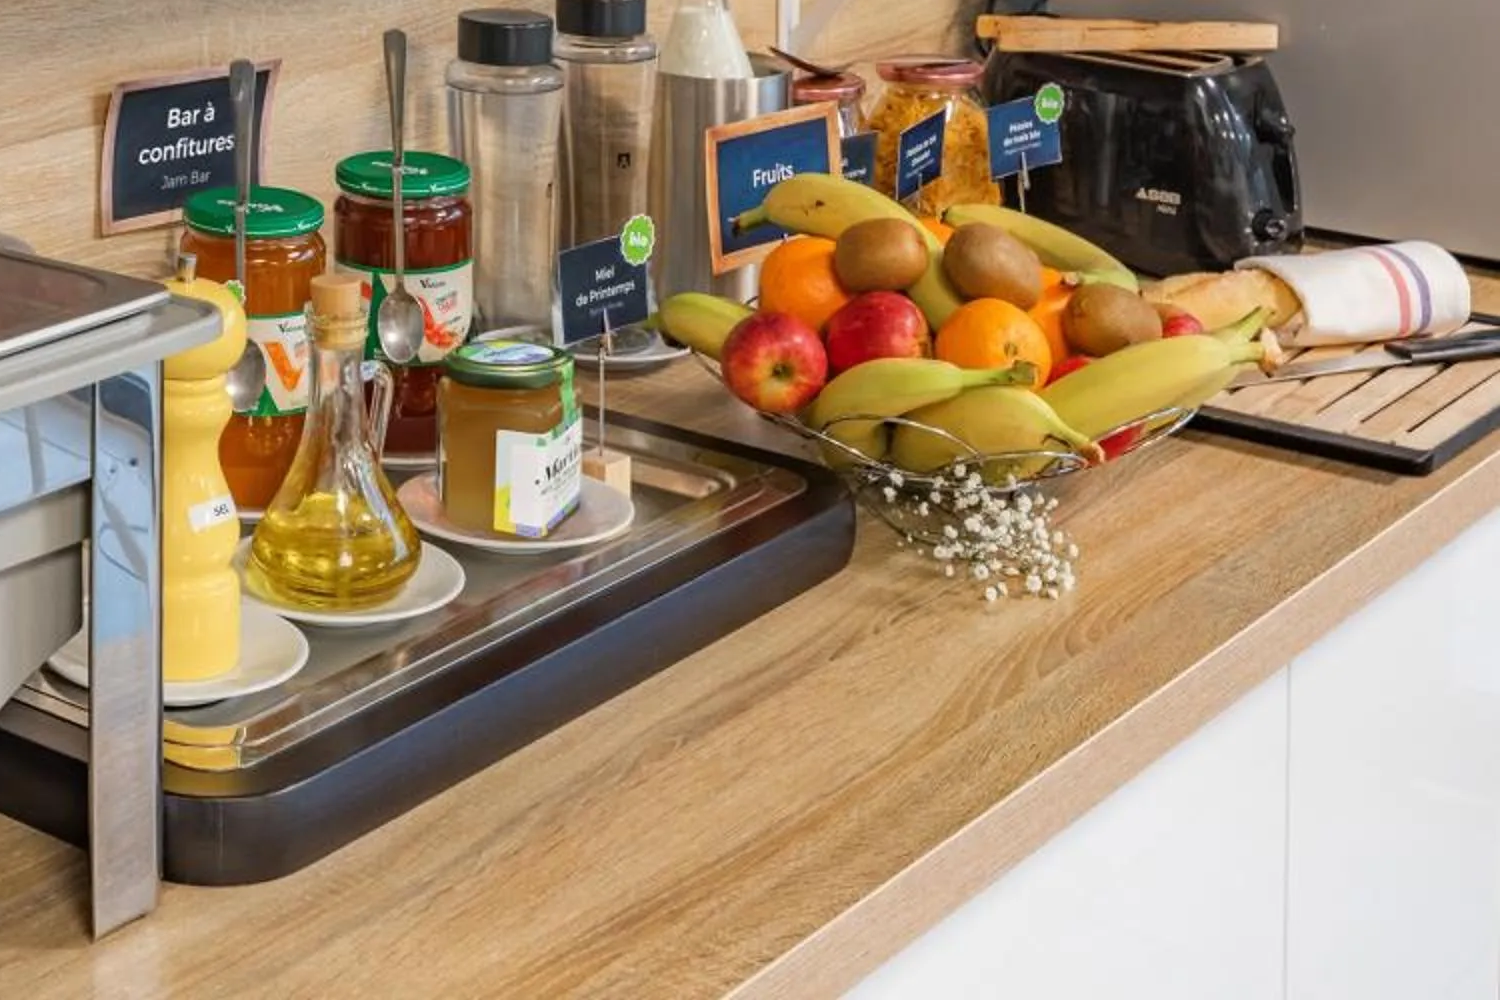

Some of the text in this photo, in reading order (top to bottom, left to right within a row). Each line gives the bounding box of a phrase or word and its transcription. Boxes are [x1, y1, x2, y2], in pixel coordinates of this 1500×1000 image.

[167, 102, 216, 128] Bar à
[138, 134, 236, 165] confitures
[160, 170, 212, 190] Jam Bar
[753, 163, 795, 188] Fruits
[595, 263, 615, 282] Miel
